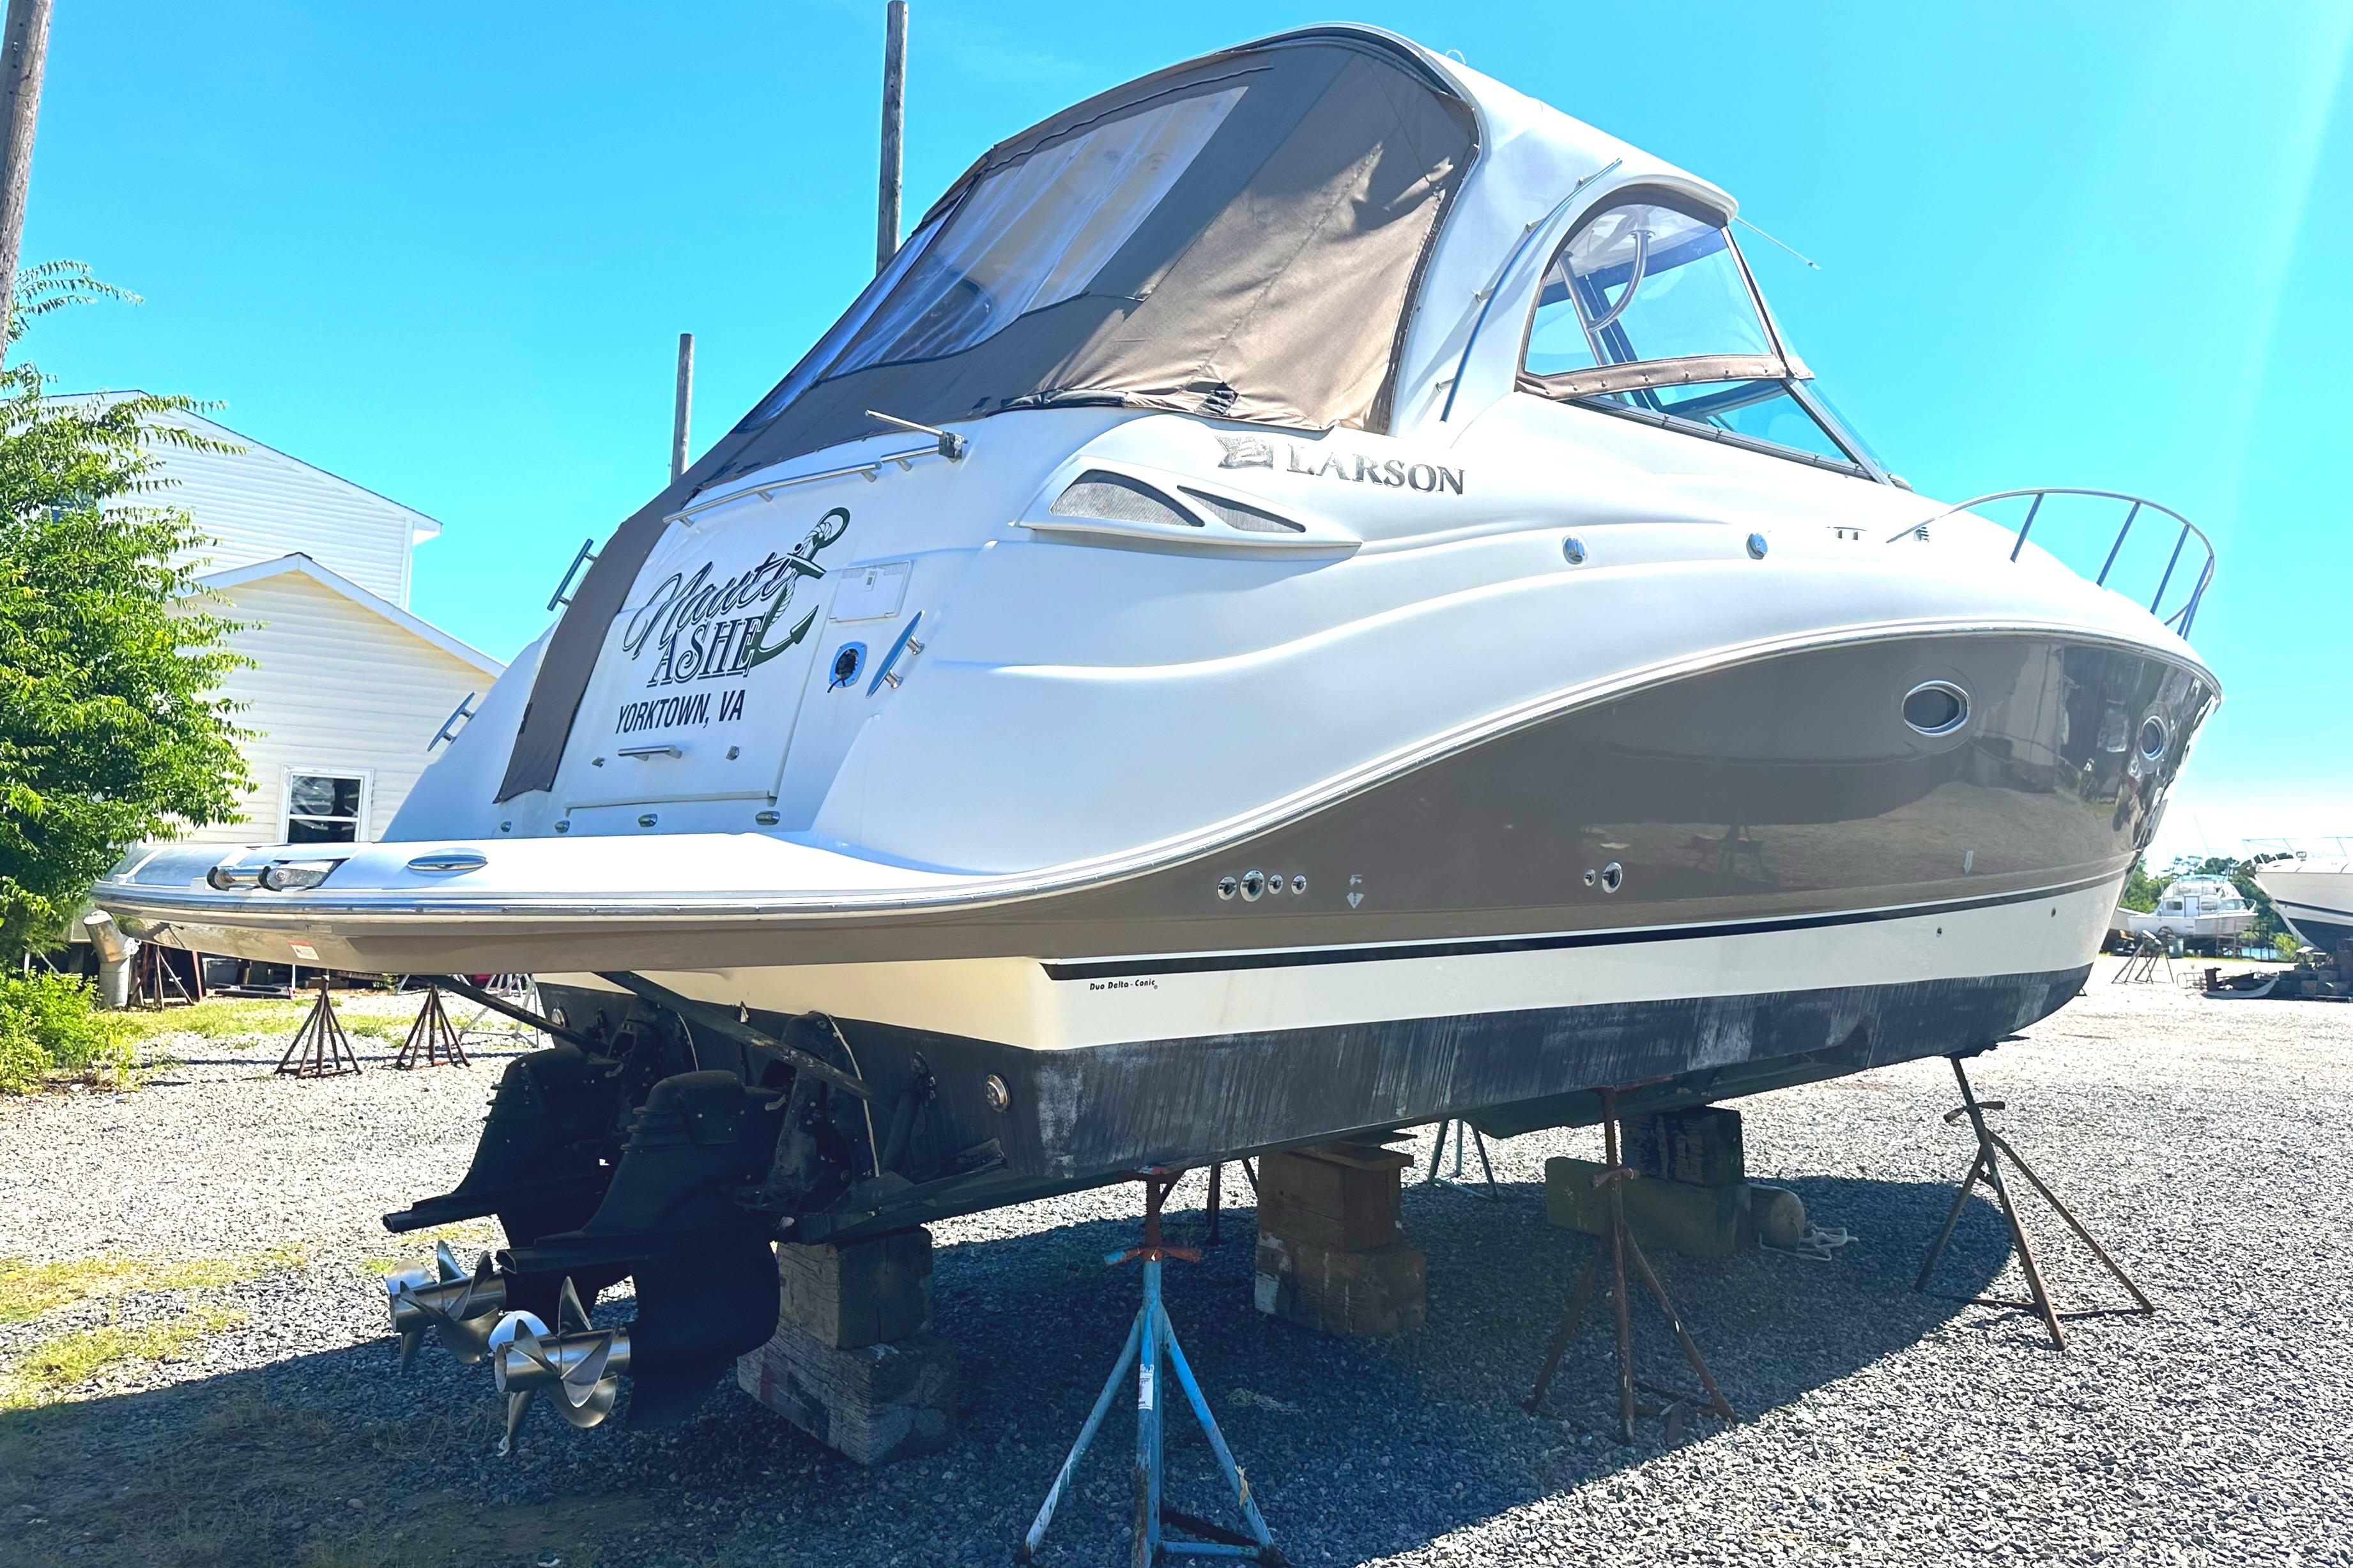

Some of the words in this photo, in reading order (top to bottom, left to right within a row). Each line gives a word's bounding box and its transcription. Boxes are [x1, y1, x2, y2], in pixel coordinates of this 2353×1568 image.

[1286, 443, 1466, 496] LARSON
[622, 544, 802, 660] Nauti
[645, 612, 769, 688] ASHE
[615, 693, 711, 734] YORKTOWN,
[719, 689, 746, 722] VA
